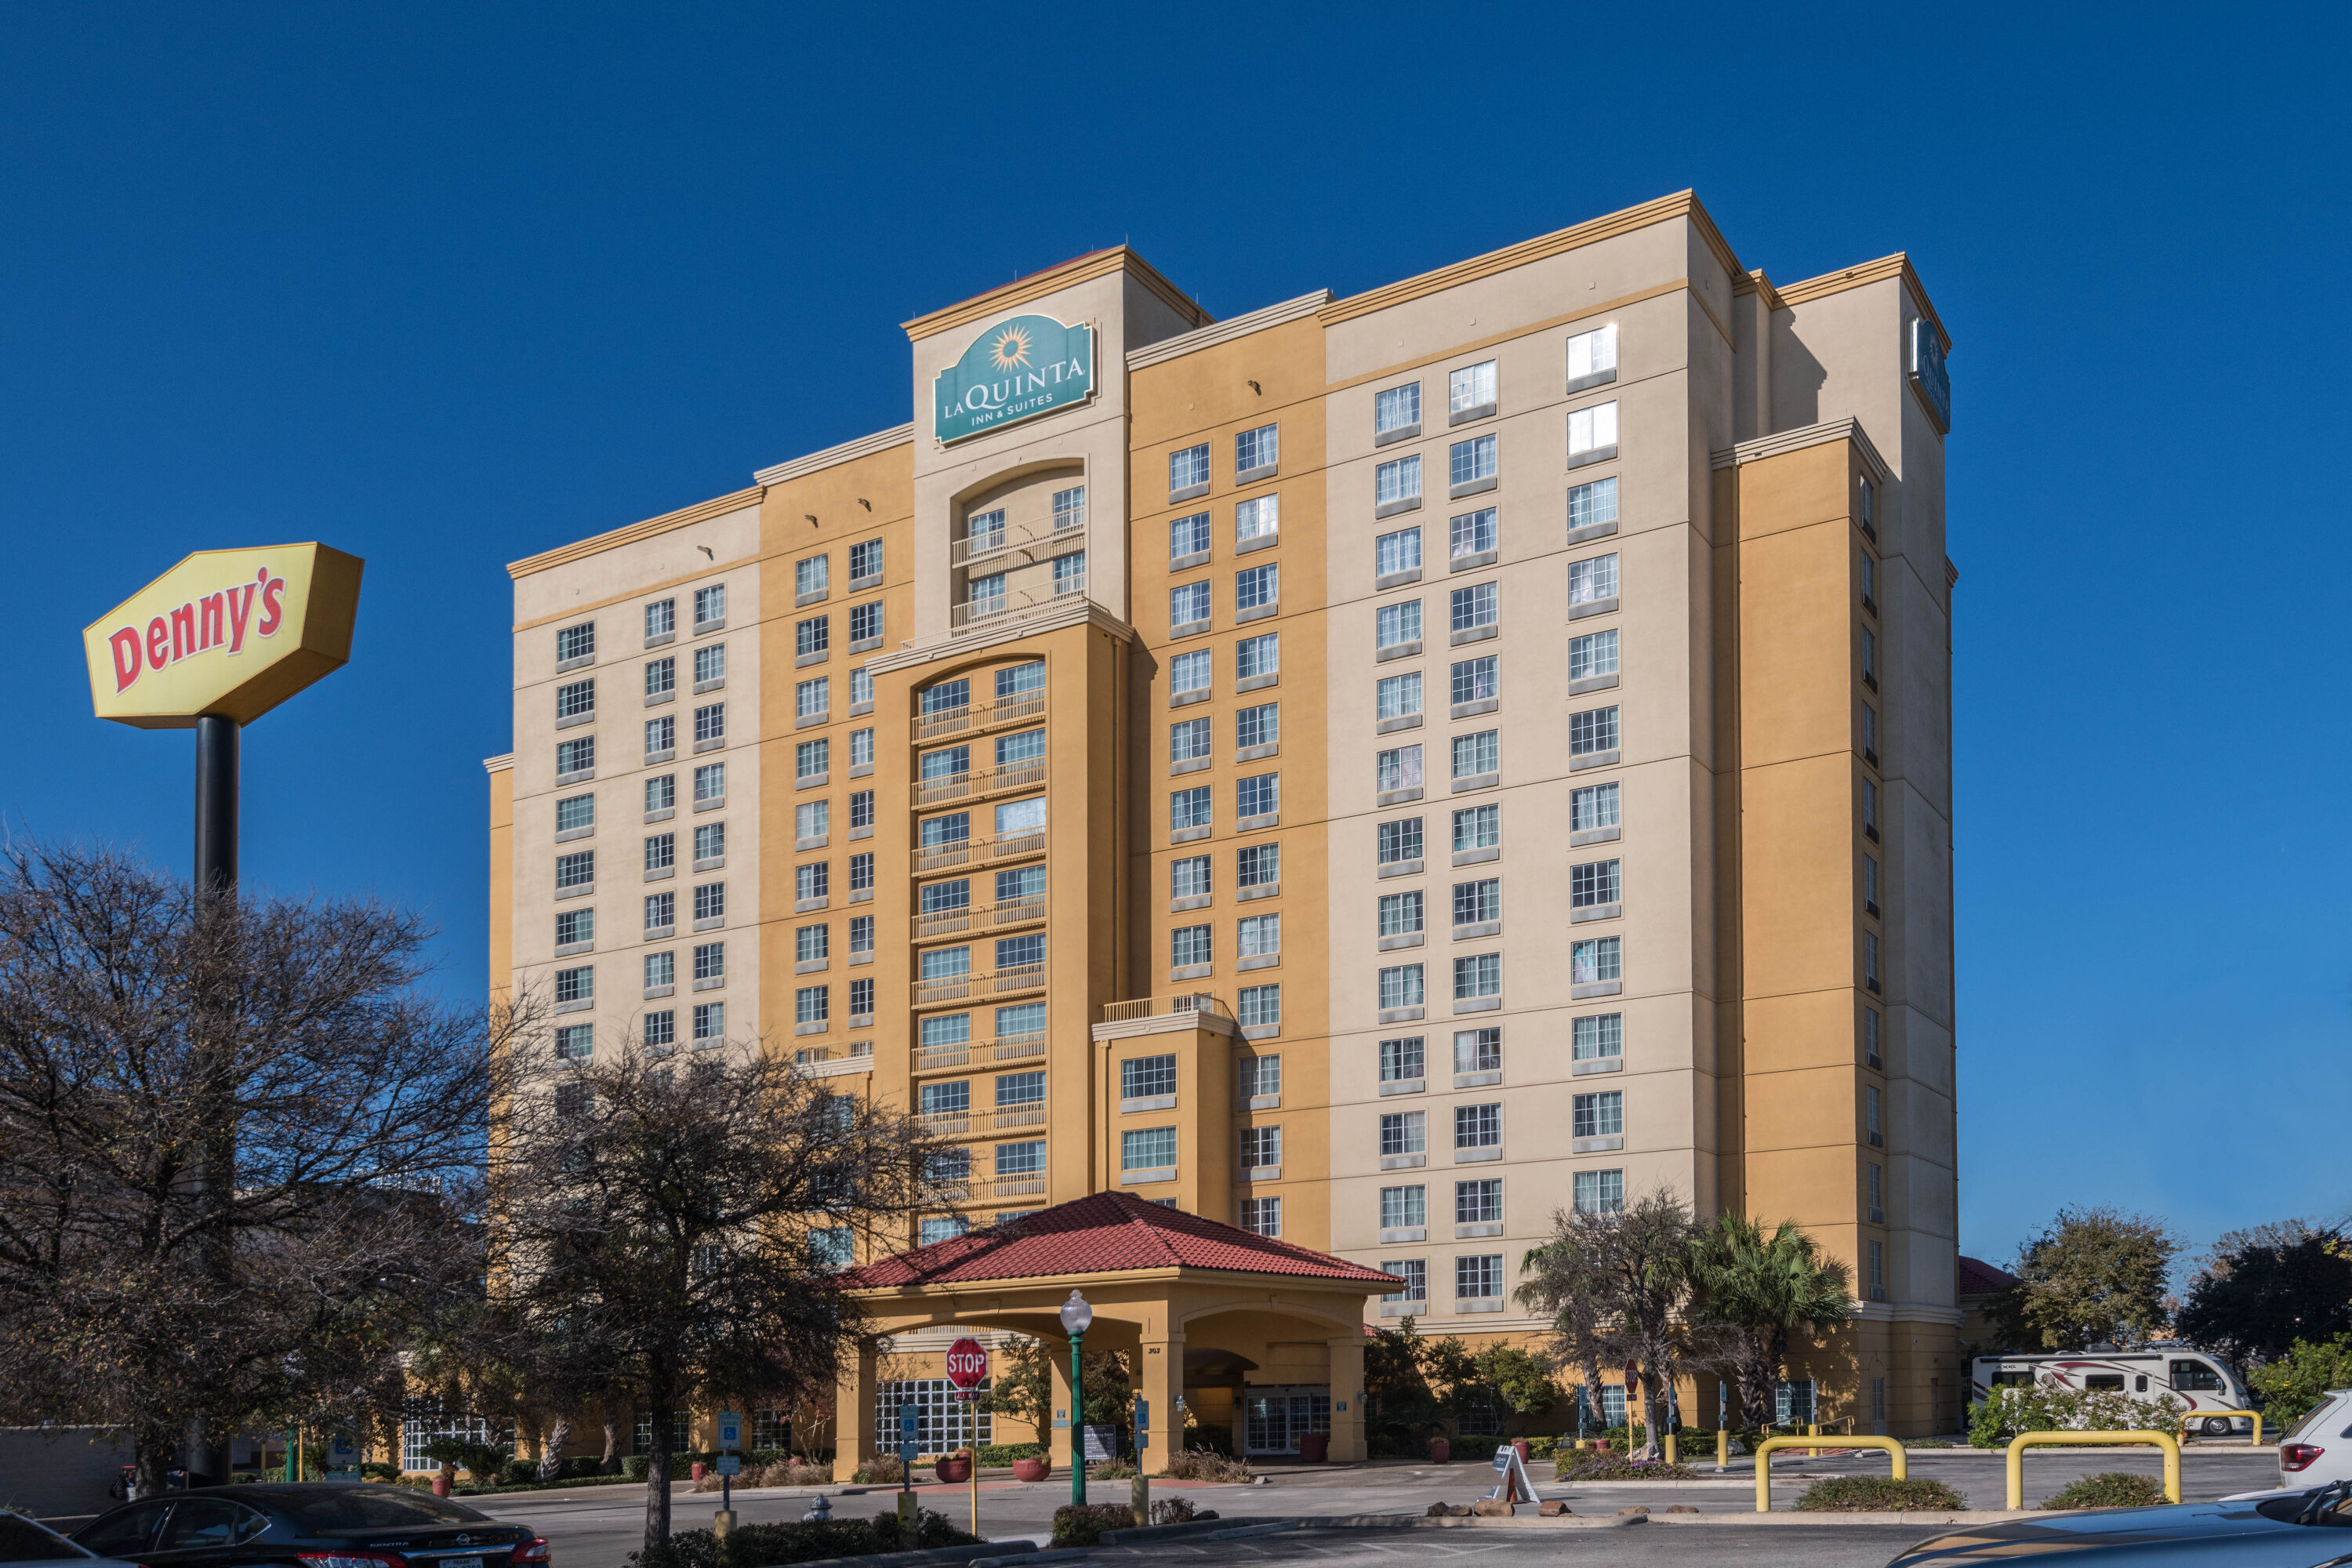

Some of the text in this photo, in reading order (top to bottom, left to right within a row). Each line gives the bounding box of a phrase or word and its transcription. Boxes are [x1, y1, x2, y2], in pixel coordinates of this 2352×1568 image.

[971, 394, 1053, 426] INN & SUITES
[107, 564, 287, 697] Denny's
[949, 1353, 985, 1374] STOP
[1626, 1370, 1638, 1383] STOP
